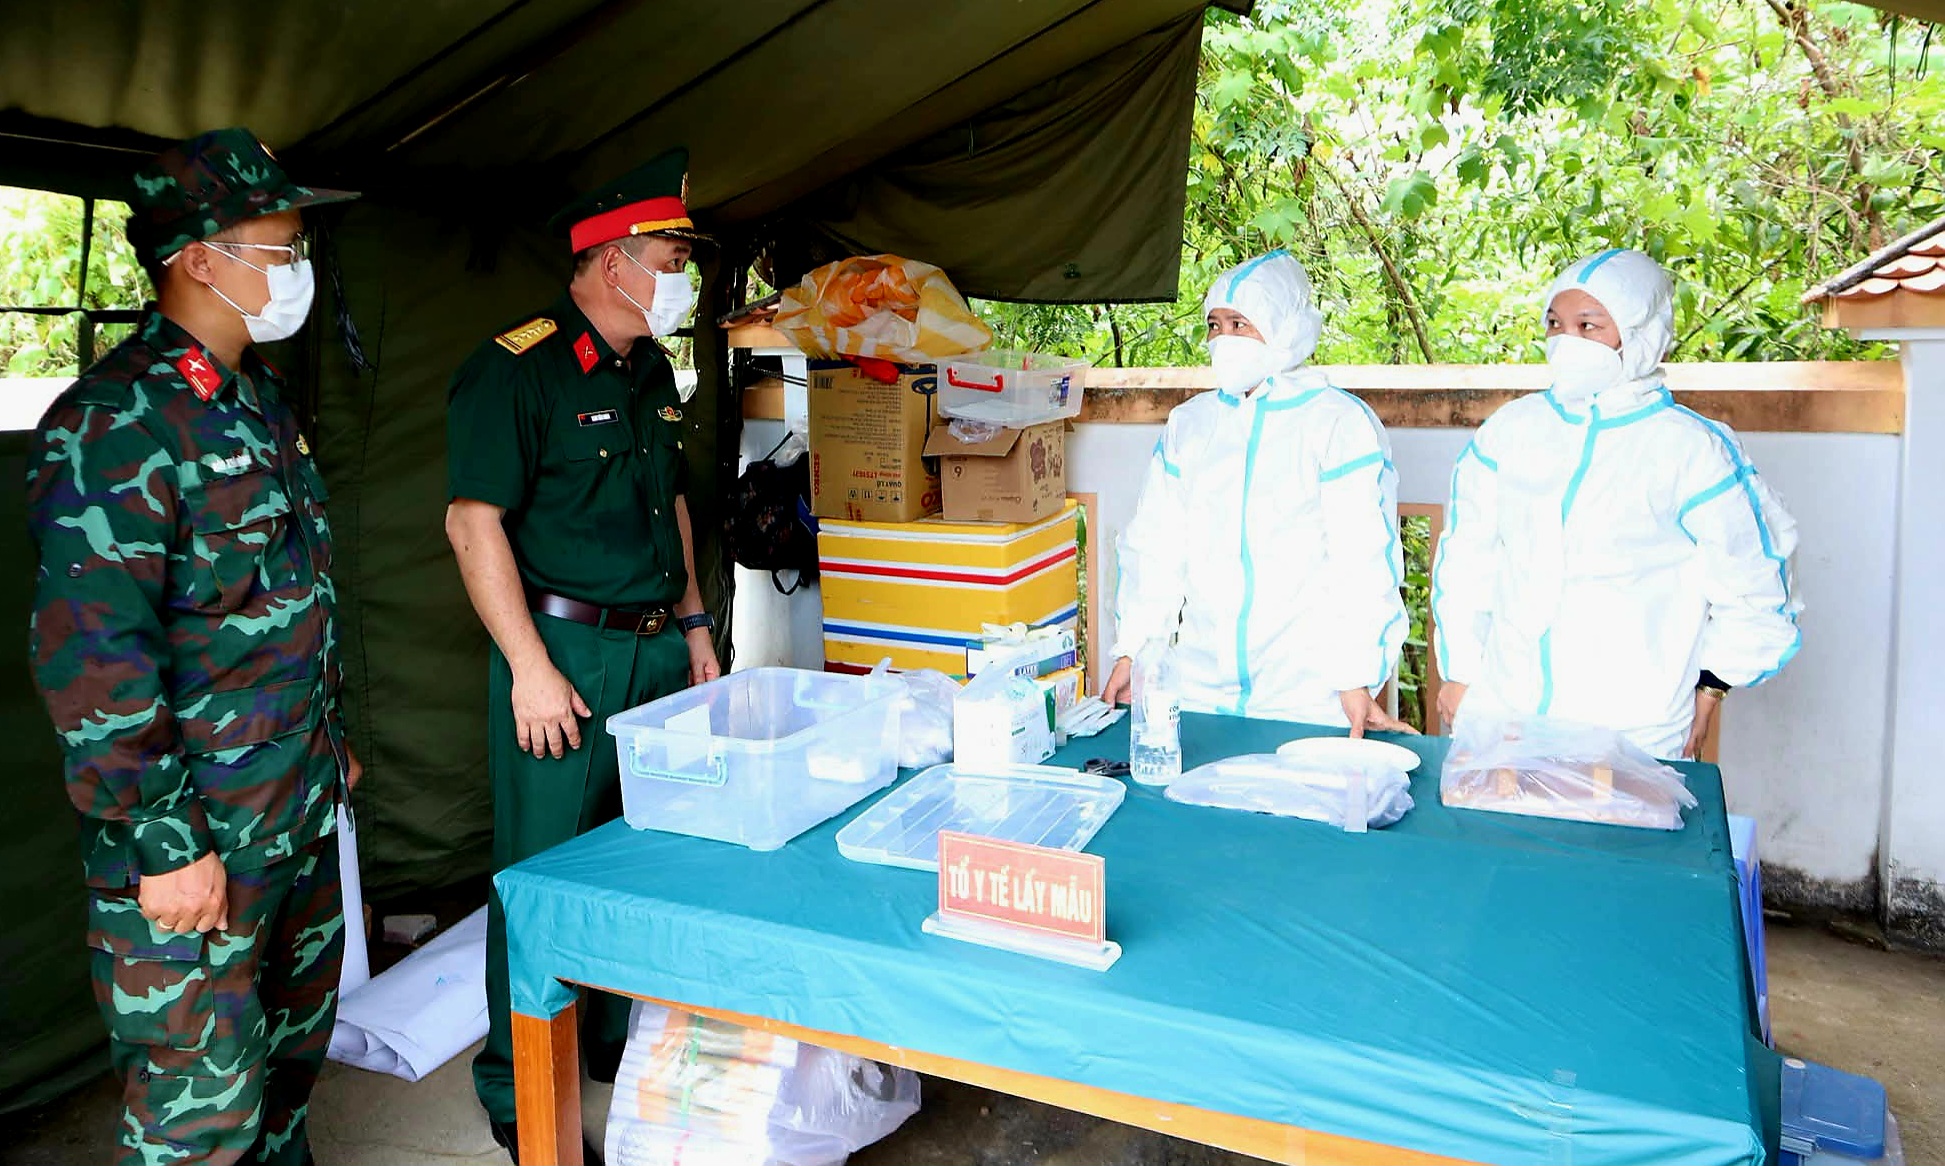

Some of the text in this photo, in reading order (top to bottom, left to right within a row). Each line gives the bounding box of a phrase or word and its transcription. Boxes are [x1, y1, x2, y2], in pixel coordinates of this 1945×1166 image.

[973, 868, 986, 903] Y
[988, 864, 1010, 907] TẾ
[1013, 867, 1046, 915] LẤY
[1050, 874, 1092, 923] MẪU
